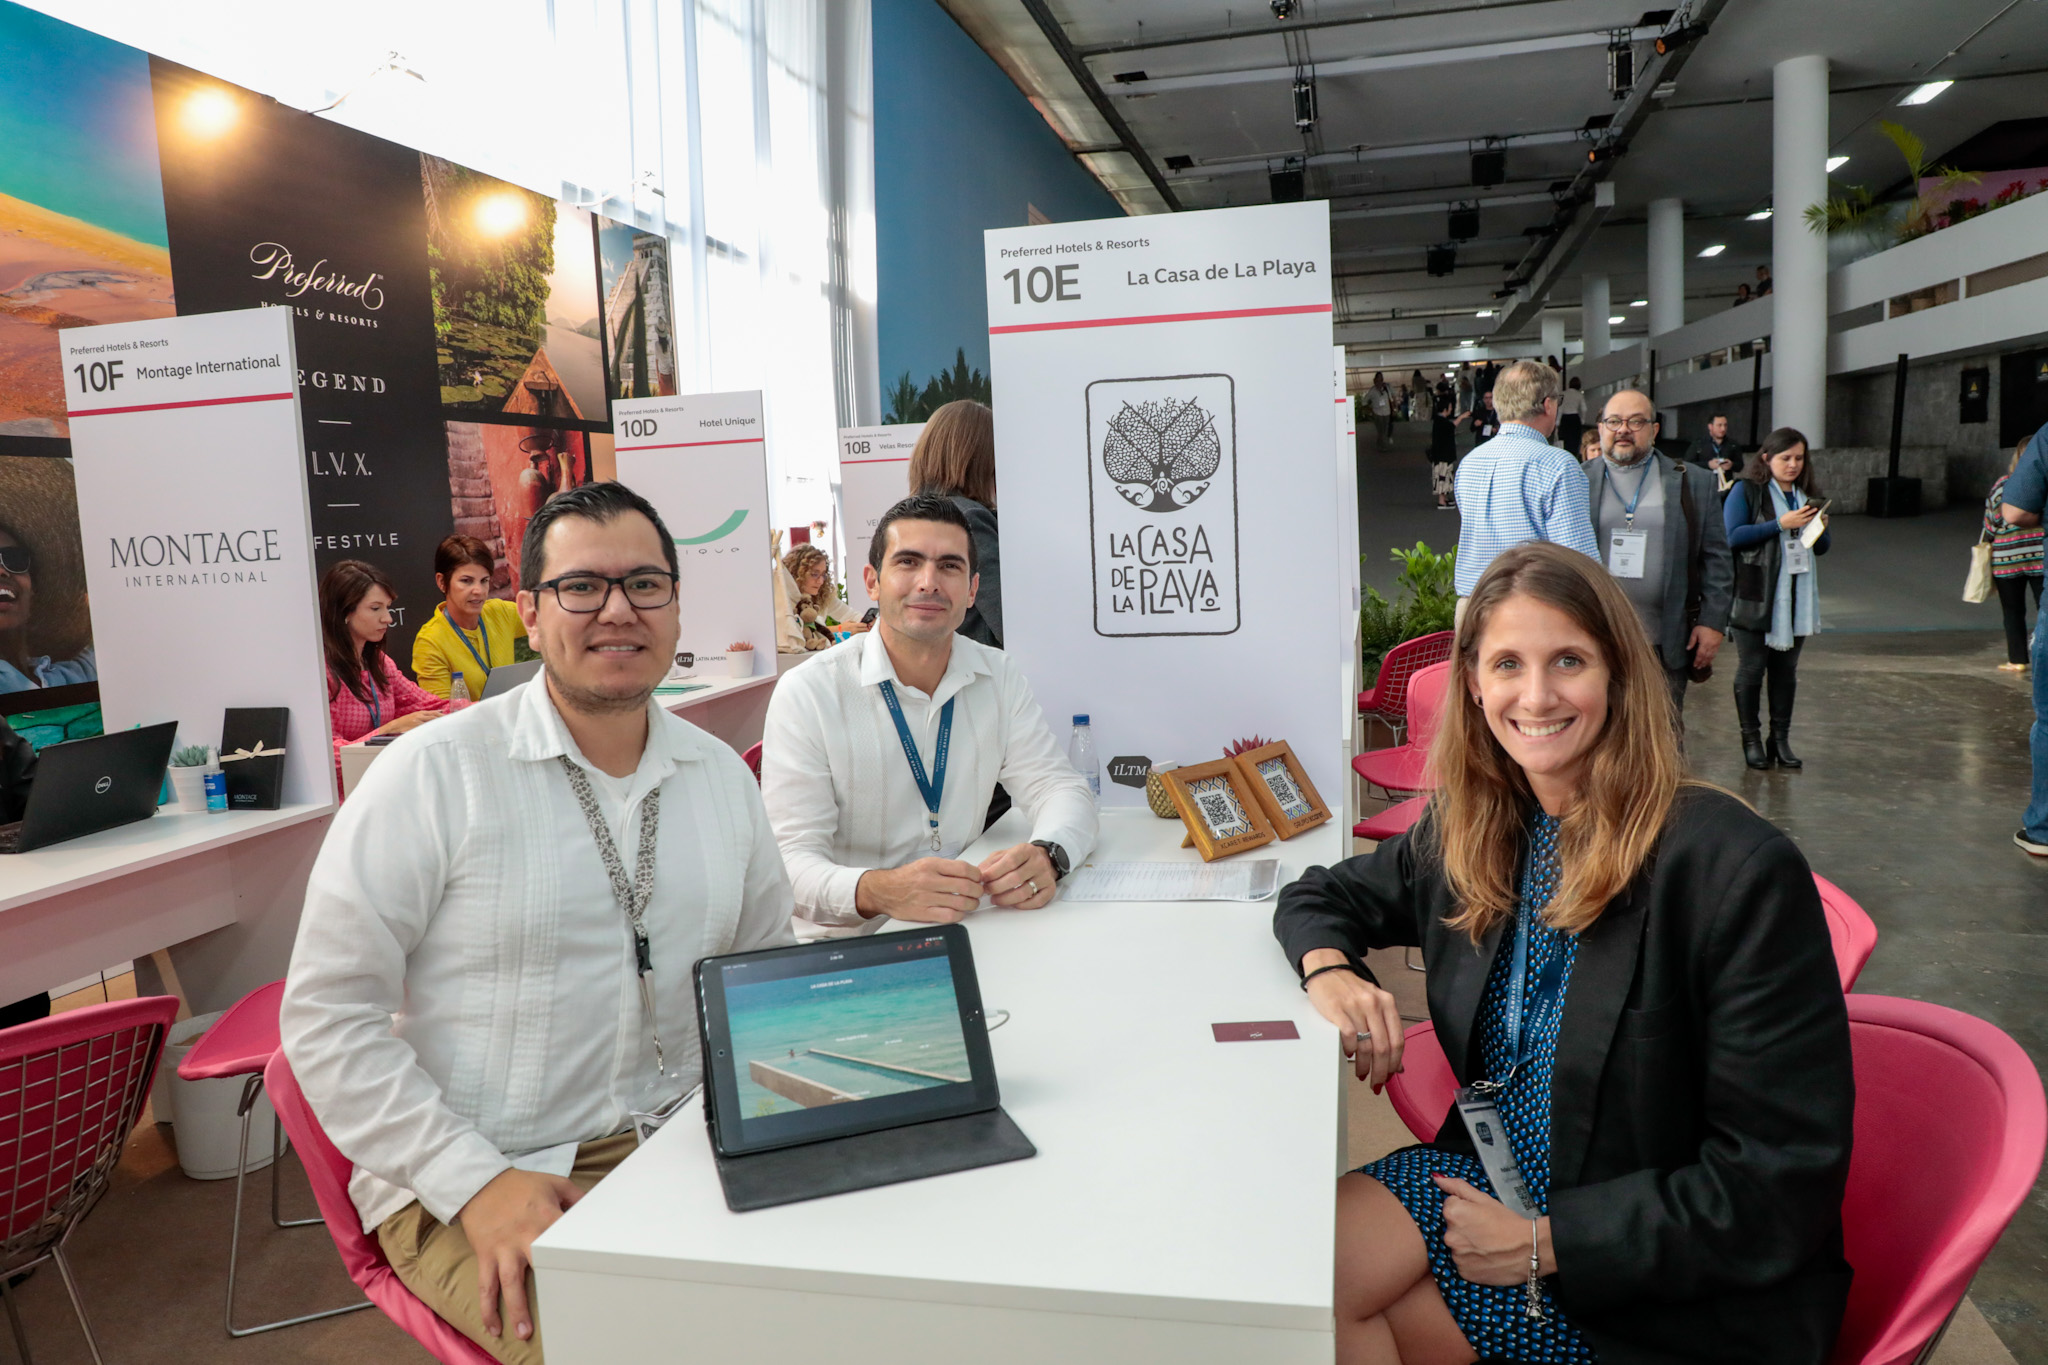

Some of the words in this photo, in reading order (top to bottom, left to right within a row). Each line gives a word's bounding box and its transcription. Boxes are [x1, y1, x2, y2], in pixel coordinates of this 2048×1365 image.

[1000, 245, 1052, 258] Preferred
[1056, 242, 1092, 253] Hotels
[1095, 241, 1103, 250] &
[1107, 238, 1150, 250] Resorts
[250, 242, 384, 310] Preferred
[1003, 263, 1081, 305] 10E
[1128, 270, 1149, 286] La
[1154, 268, 1200, 283] Casa
[1205, 264, 1228, 280] de
[1235, 262, 1257, 278] La
[1263, 259, 1316, 278] Playa
[316, 309, 324, 320] &
[330, 313, 378, 328] RESORTS
[71, 345, 105, 355] Preferred
[107, 342, 131, 352] Hotels
[140, 339, 168, 348] Resorts
[73, 360, 124, 393] 10F
[137, 365, 192, 380] Montage
[196, 354, 280, 374] International
[298, 370, 386, 393] EGEND
[621, 419, 657, 437] 10D
[700, 419, 722, 427] Hotel
[725, 417, 755, 426] Unique
[845, 441, 871, 454] 10B
[110, 530, 281, 568] MONTAGE
[314, 532, 400, 550] FESTYLE
[1110, 533, 1135, 557] LA
[1138, 524, 1213, 566] CASA
[126, 571, 267, 587] INTERNATIONAL
[1112, 566, 1135, 590] DE
[1113, 595, 1134, 612] LA
[1140, 569, 1218, 615] PLAYA
[884, 690, 893, 709] BRANDS
[903, 740, 913, 760] LUXURY
[912, 761, 920, 780] BRANDS
[1221, 839, 1240, 849] XCARET
[1242, 832, 1265, 842] REWARDS
[1527, 1029, 1536, 1054] LUXURY
[1535, 999, 1549, 1027] BRANDS
